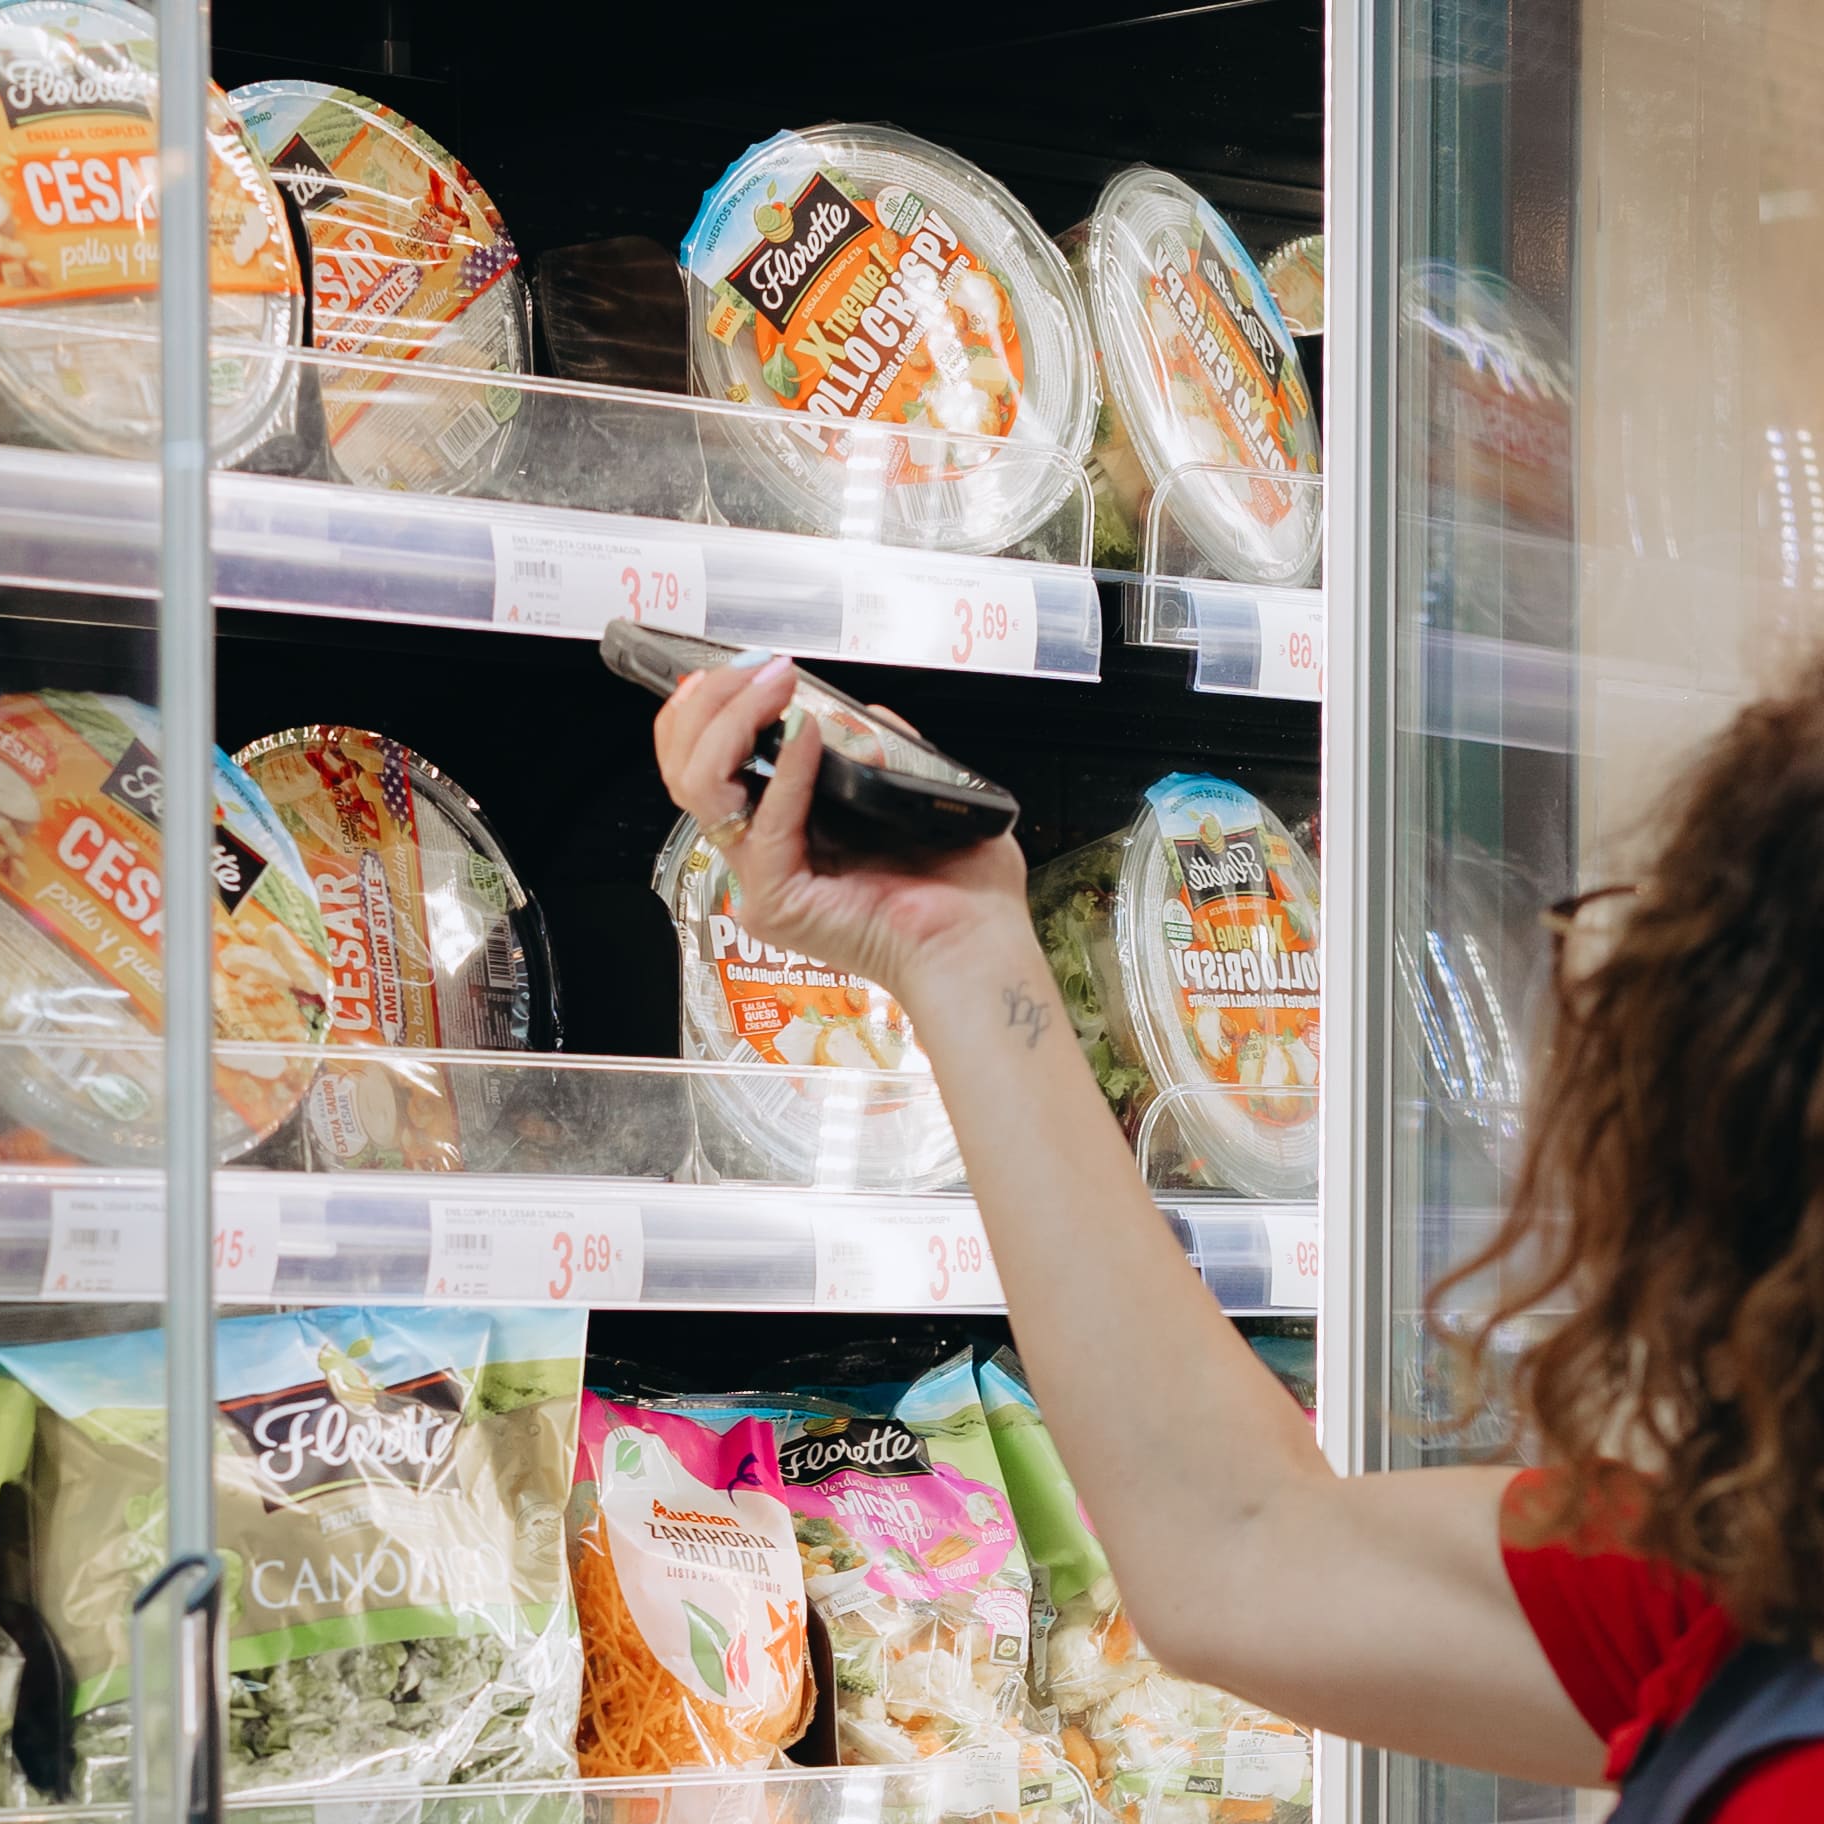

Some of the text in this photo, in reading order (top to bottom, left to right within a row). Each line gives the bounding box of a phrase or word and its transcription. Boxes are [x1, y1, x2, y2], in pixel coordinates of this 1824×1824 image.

[5, 58, 144, 110] Florette
[22, 146, 160, 226] CÉSA
[705, 204, 733, 255] HUERTOS
[749, 202, 851, 310] Florette
[59, 238, 112, 280] pollo
[113, 249, 128, 277] y
[313, 229, 392, 313] SAR
[801, 245, 864, 320] ENSALADA COMPLETA
[373, 275, 410, 316] STYLE
[714, 305, 738, 338] NUEVO
[788, 336, 882, 455] POLLO
[619, 566, 680, 625] 3.79
[951, 598, 1008, 665] 3.69
[37, 881, 94, 942] pollo
[372, 876, 398, 1026] AMERICAN STYLE
[741, 1000, 768, 1012] SALSA
[743, 1009, 780, 1022] QUESO
[548, 1231, 611, 1300] 3.69
[928, 1235, 982, 1301] 3.69
[252, 1397, 455, 1482] Florette
[777, 1425, 920, 1480] Florette
[643, 1521, 780, 1553] ZANAHORIA
[651, 1498, 741, 1529] Auchan
[828, 1489, 924, 1530] MICRO
[671, 1542, 771, 1578] RALLADA
